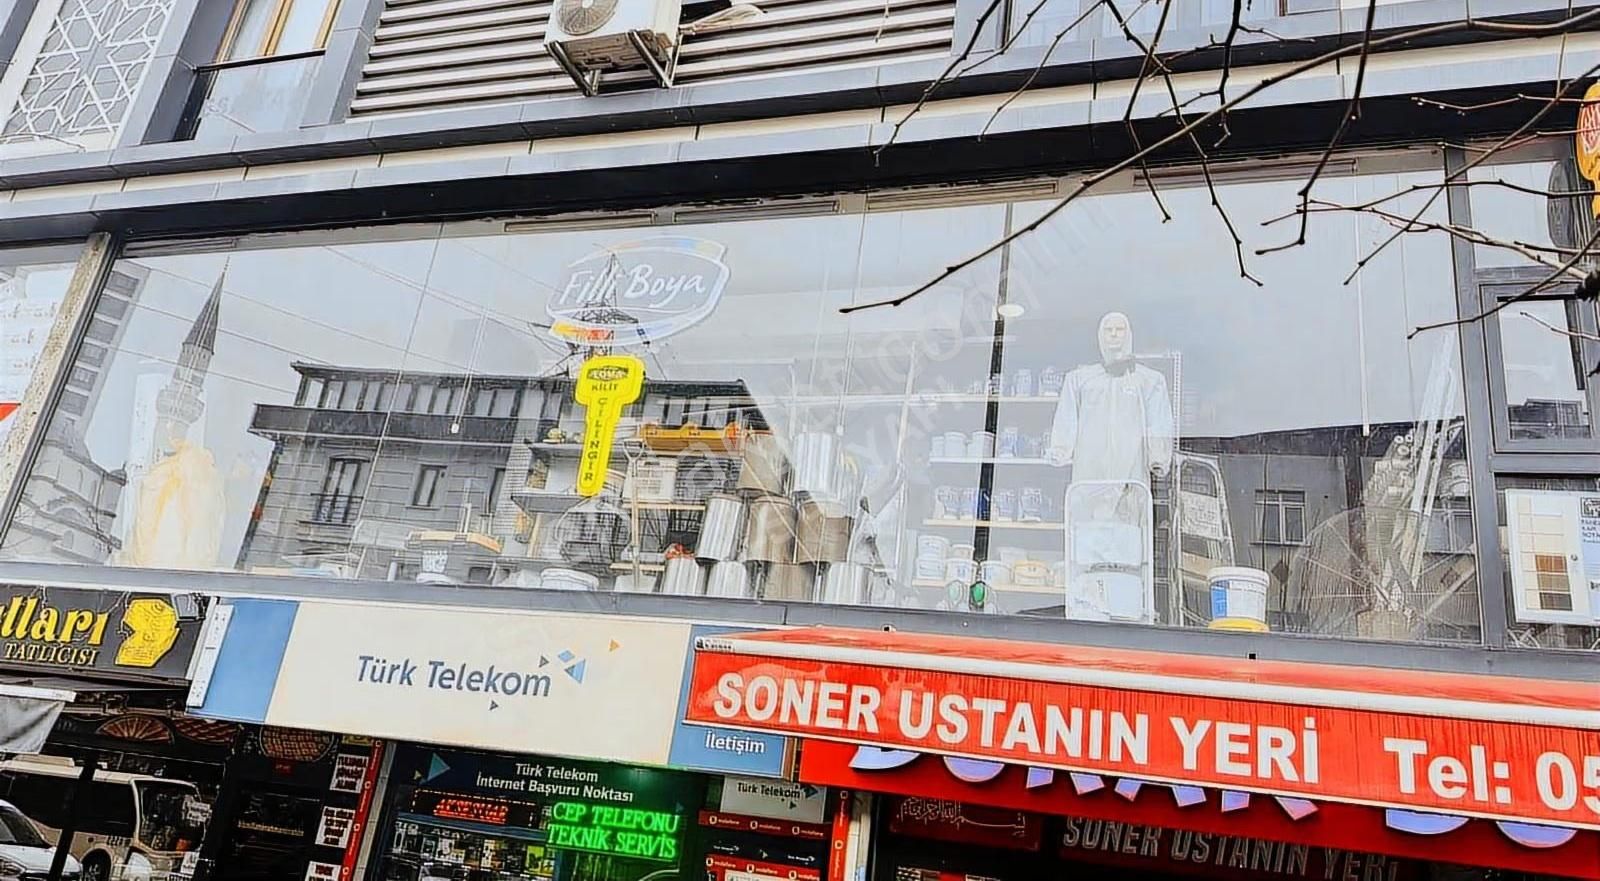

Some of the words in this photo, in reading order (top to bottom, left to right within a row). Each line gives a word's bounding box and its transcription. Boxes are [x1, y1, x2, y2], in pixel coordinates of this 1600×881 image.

[560, 265, 622, 306] Filli
[624, 264, 707, 309] Boya
[4, 642, 99, 666] TATLICISI
[357, 655, 417, 687] Türk
[427, 661, 551, 698] Telekom
[704, 728, 766, 758] İletişim
[713, 671, 882, 734] SONER
[898, 688, 1149, 765] USTANIN
[1169, 714, 1320, 785] YERİ
[1383, 736, 1512, 804] Tel:
[476, 771, 525, 792] İnternet
[527, 777, 581, 799] Başvuru
[583, 783, 635, 803] Noktası
[515, 762, 543, 778] Türk
[545, 765, 599, 783] Telekom
[737, 782, 758, 794] Türk
[760, 785, 801, 799] Telekom
[553, 800, 586, 825] CEP
[591, 806, 681, 834] TELEFONU
[548, 822, 612, 851] TEKNİK
[614, 829, 678, 859] SERVİS
[1064, 813, 1162, 857] SONER
[1172, 826, 1309, 873] USTANIN
